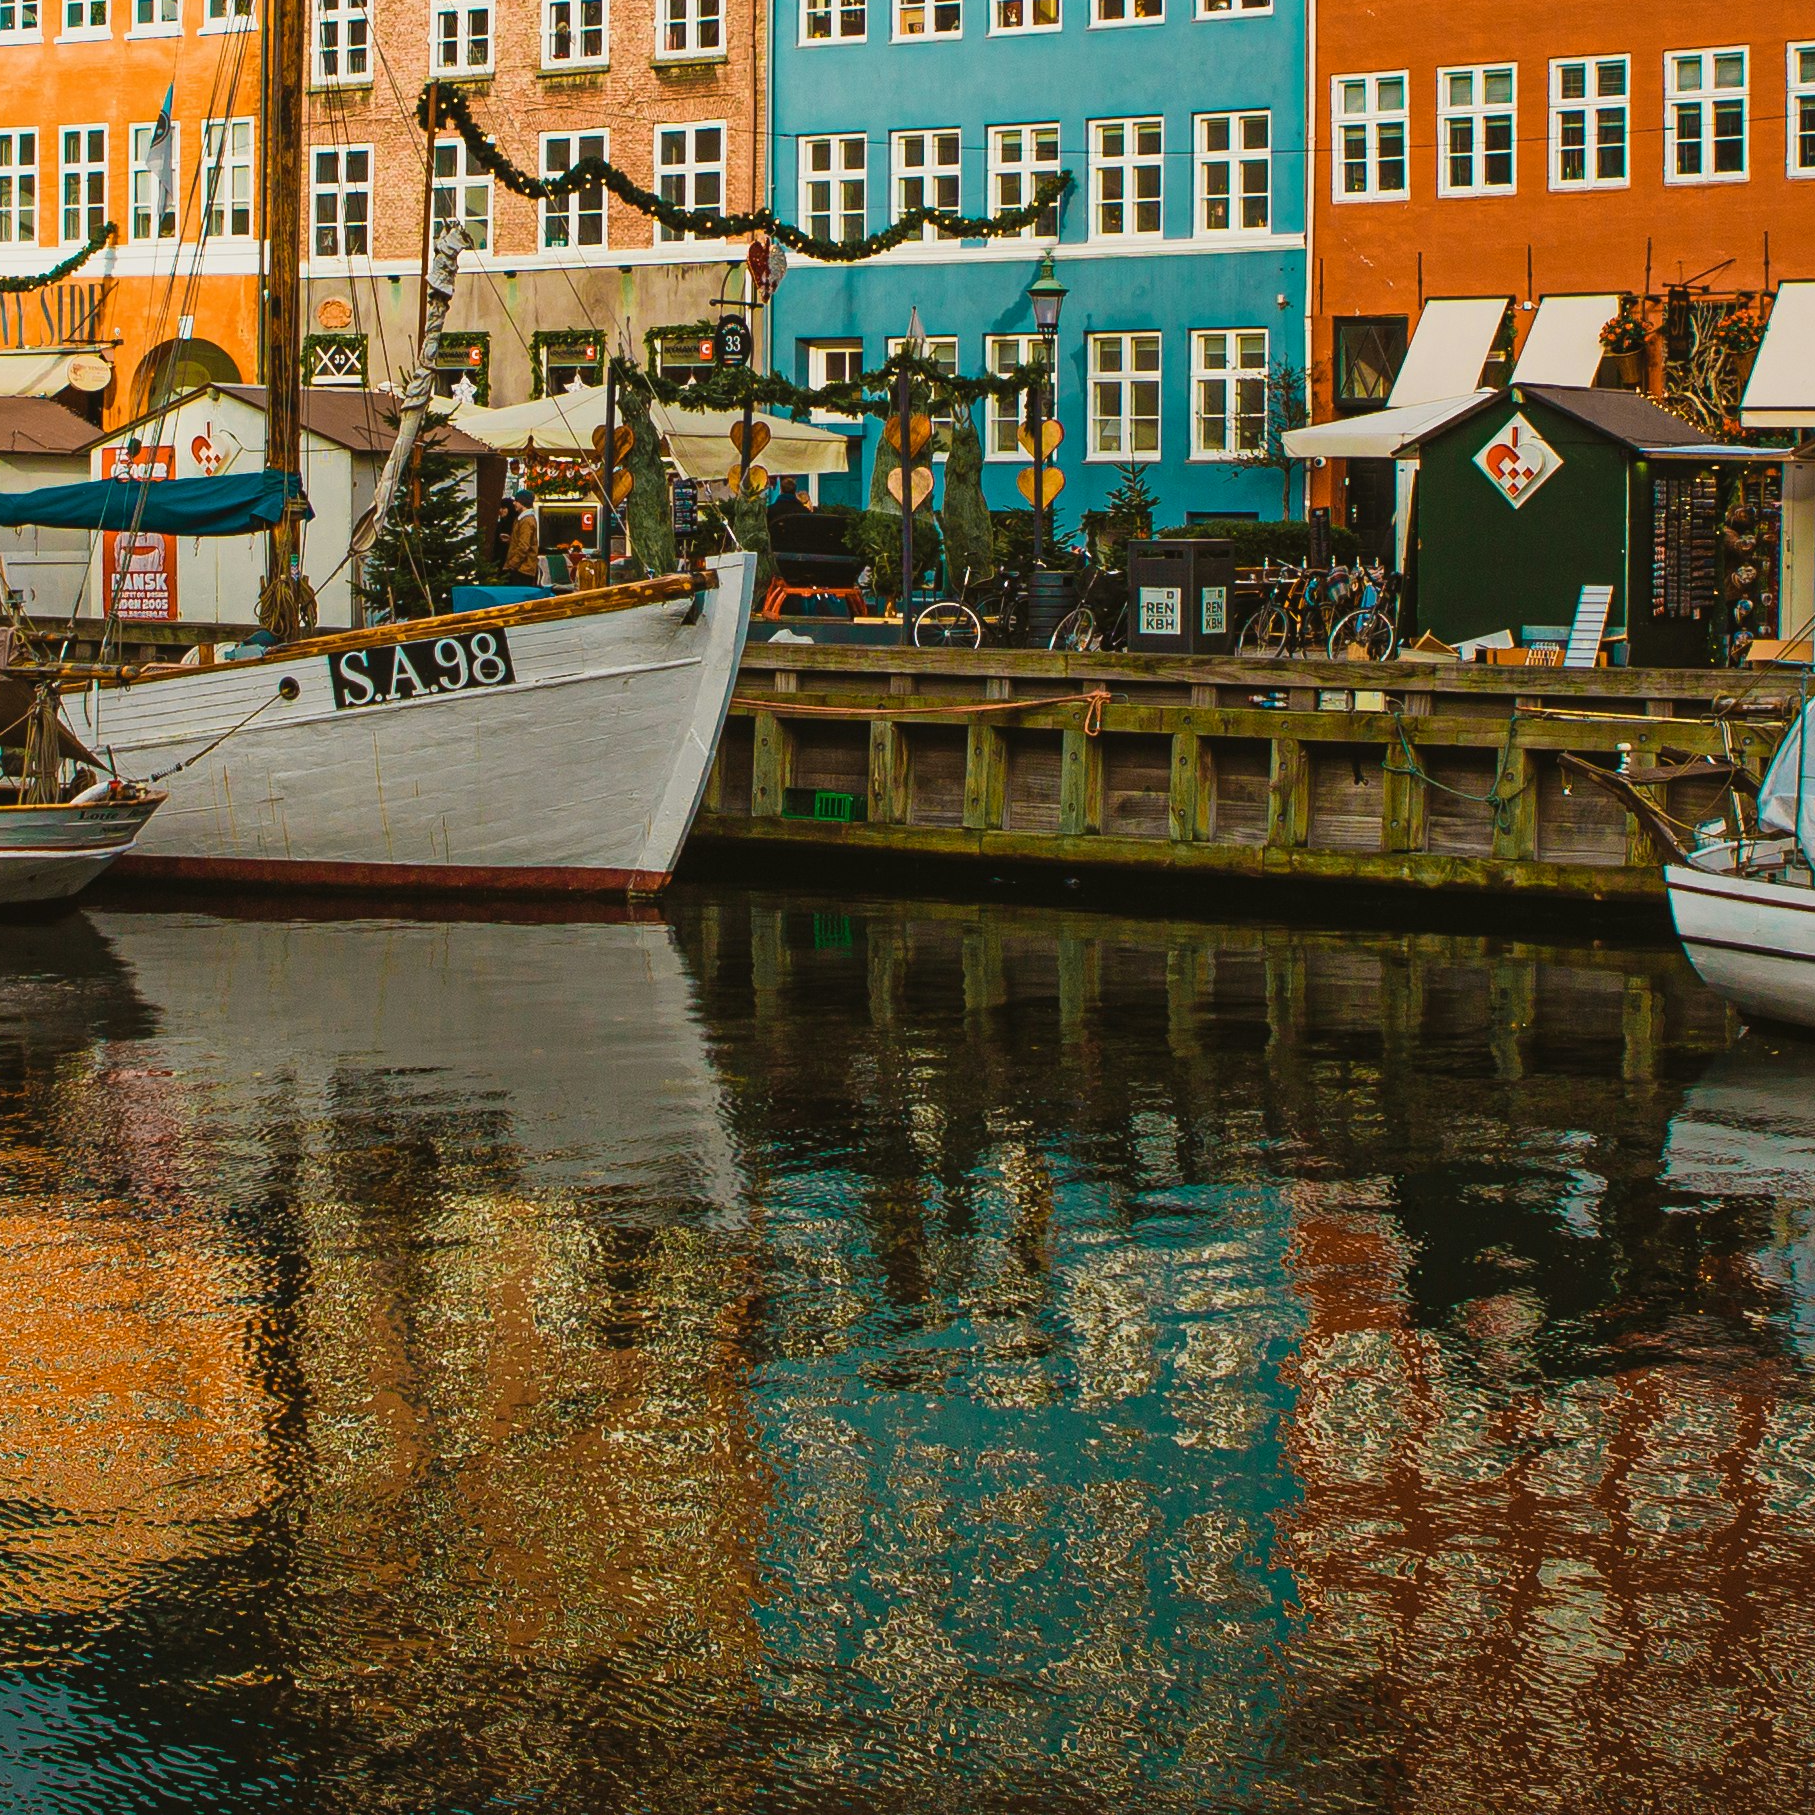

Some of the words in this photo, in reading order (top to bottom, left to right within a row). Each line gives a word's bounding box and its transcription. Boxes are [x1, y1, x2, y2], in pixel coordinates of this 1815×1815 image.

[702, 344, 710, 354] C
[725, 336, 741, 352] 33
[471, 349, 479, 359] C
[586, 347, 593, 356] C
[334, 354, 345, 364] 33
[583, 513, 592, 525] C
[142, 598, 169, 610] 2005
[1146, 601, 1175, 615] REN
[1205, 601, 1223, 614] REN
[1146, 617, 1175, 630] KBH
[1205, 617, 1223, 630] KBH
[339, 632, 506, 706] S.A.98
